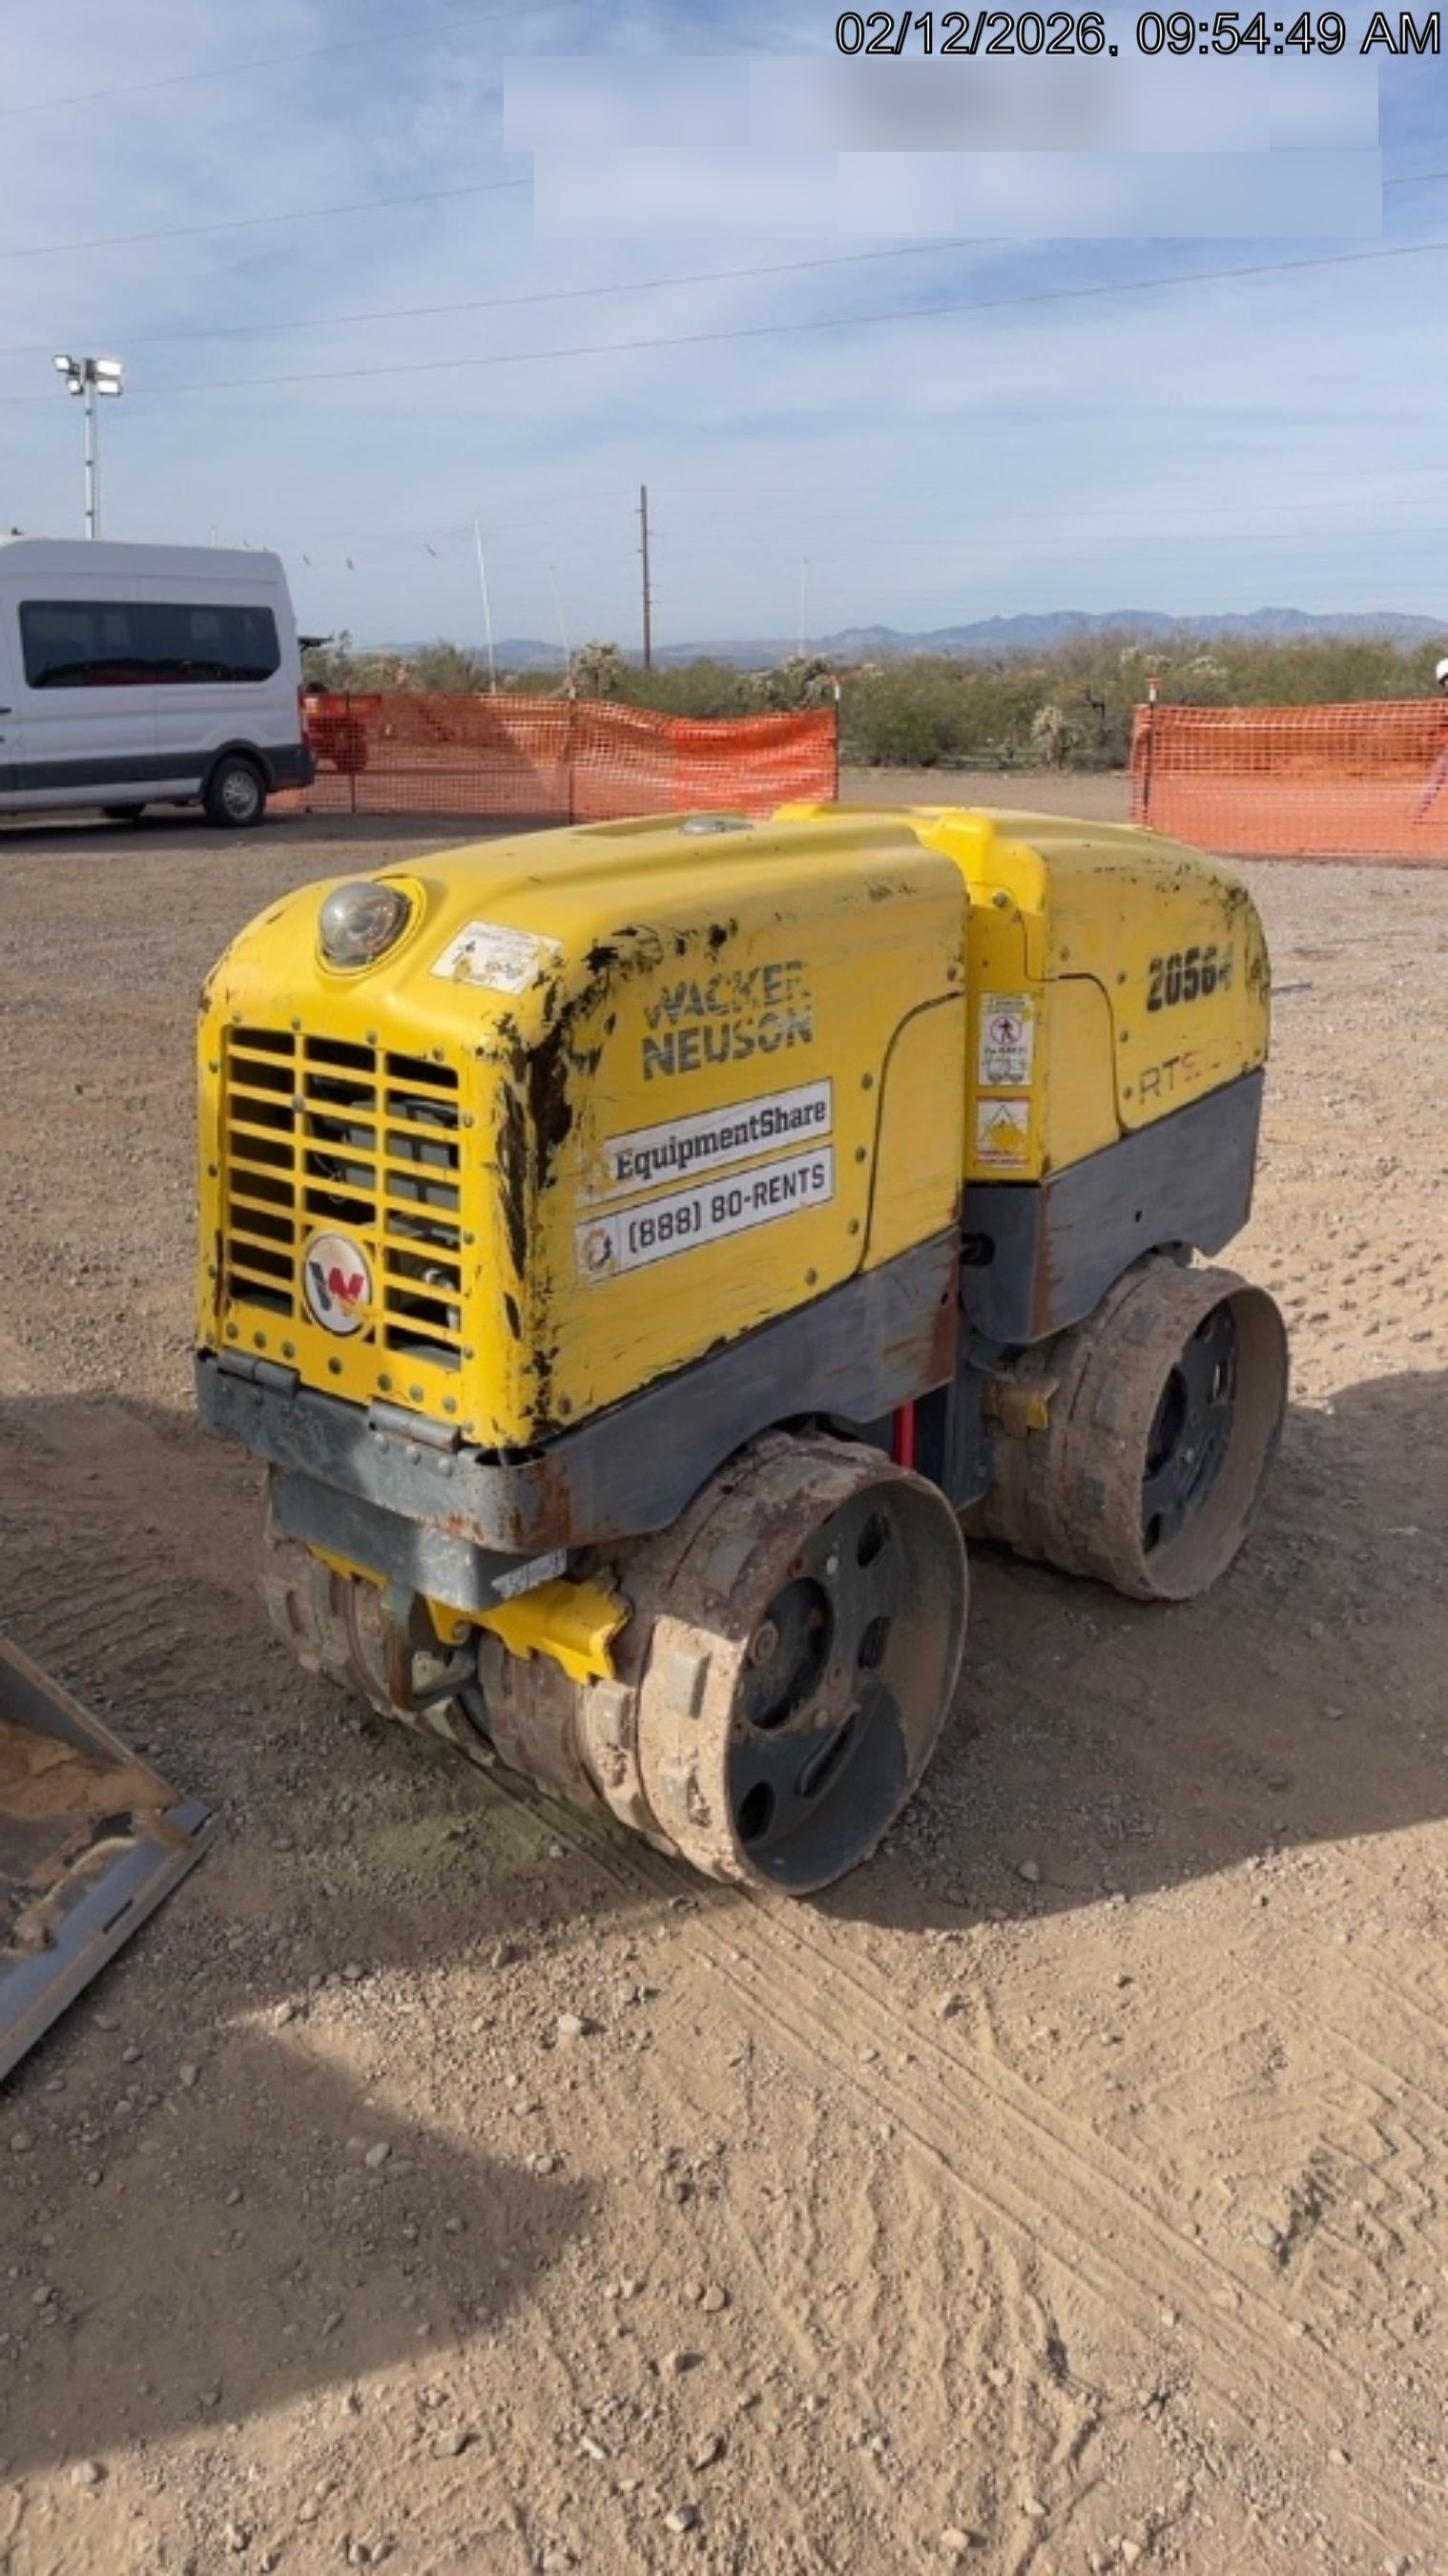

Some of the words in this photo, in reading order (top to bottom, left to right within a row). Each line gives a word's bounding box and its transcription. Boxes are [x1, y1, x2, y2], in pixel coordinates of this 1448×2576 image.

[641, 1005, 813, 1081] NEUSON
[616, 1101, 825, 1180] EquipmentShare
[629, 1201, 701, 1254] (888)
[712, 1164, 825, 1223] 80-RENTS
